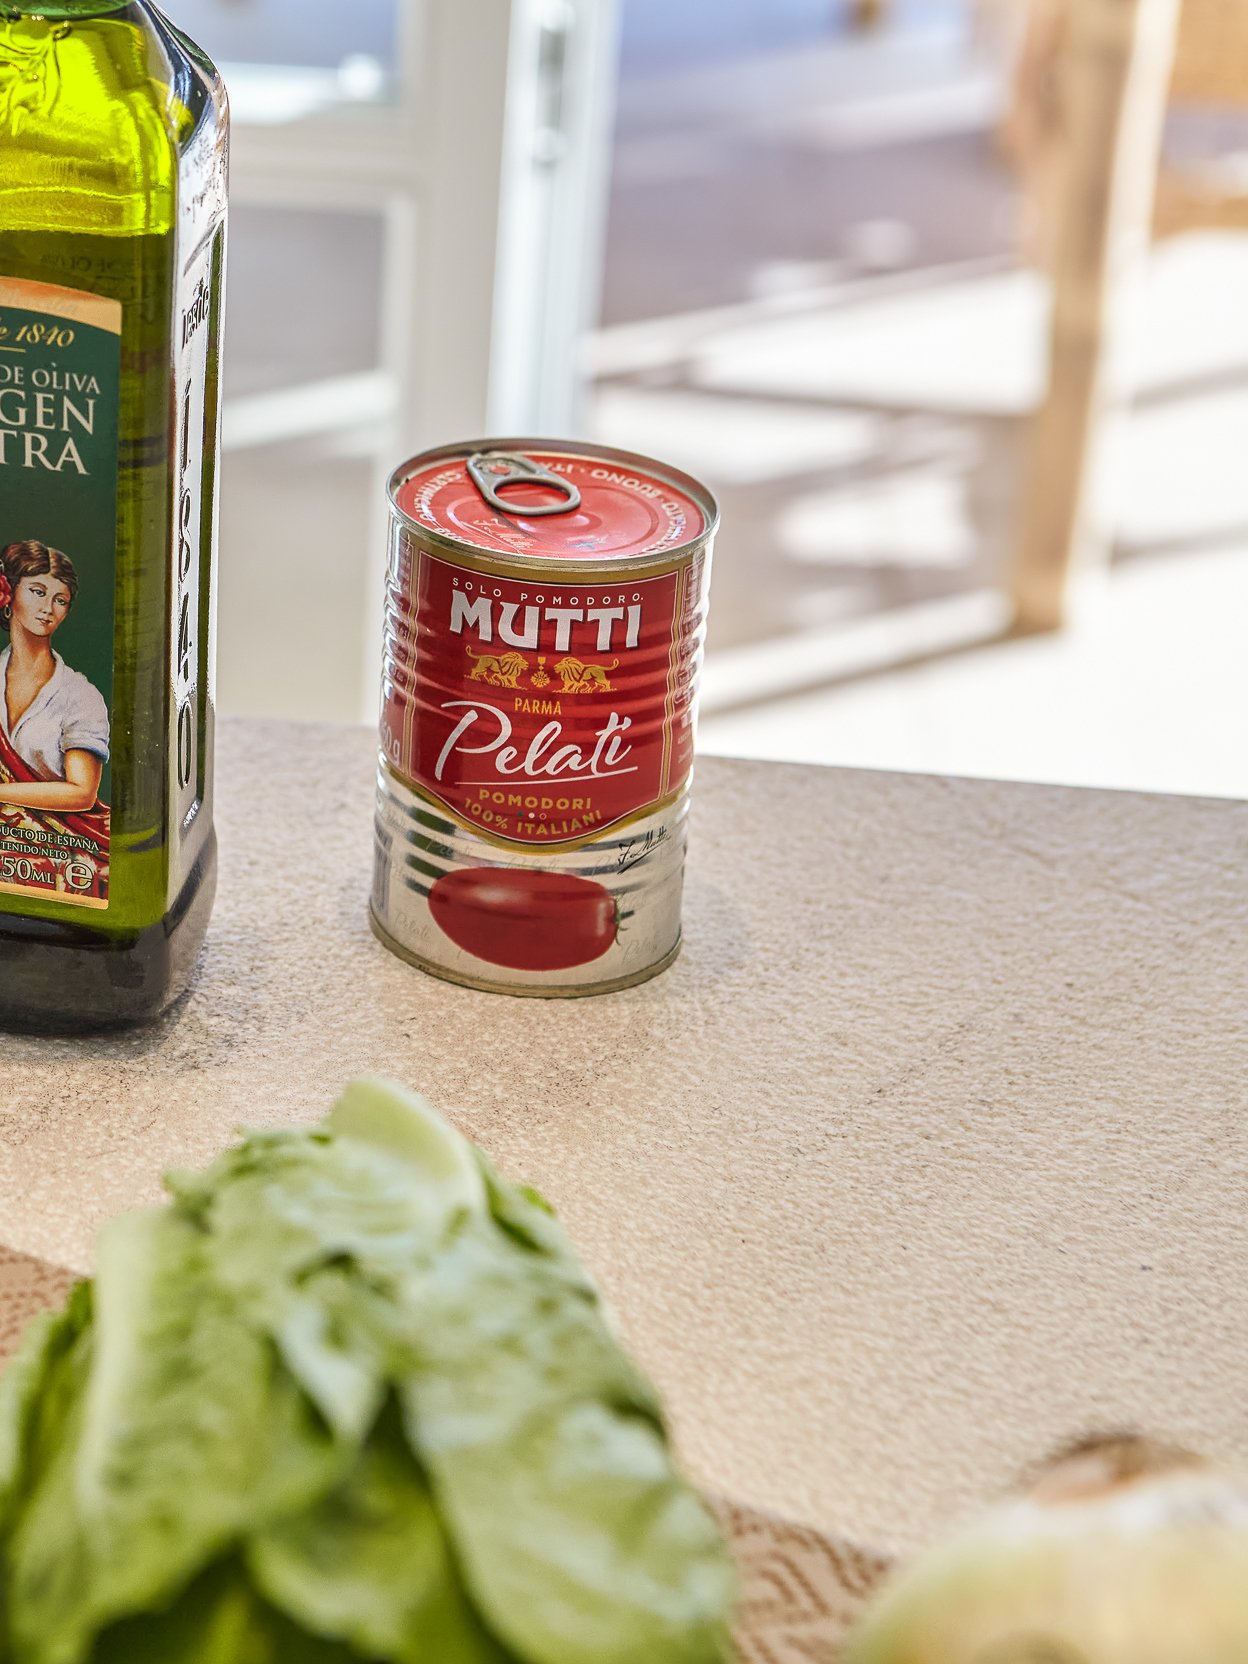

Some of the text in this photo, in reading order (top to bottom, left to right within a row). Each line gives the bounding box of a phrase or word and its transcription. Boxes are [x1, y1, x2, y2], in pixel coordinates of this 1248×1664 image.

[15, 323, 75, 348] 1840
[32, 367, 101, 394] OLIVA
[452, 577, 502, 597] SOLO
[449, 589, 643, 652] MUTTI
[514, 697, 562, 716] PARMA
[434, 700, 633, 781] Pelati
[478, 788, 591, 811] POMODORI
[464, 798, 602, 836] 100% ITALIANI
[38, 831, 53, 843] DE
[57, 834, 99, 852] ESPAÑA
[41, 848, 68, 860] NETO
